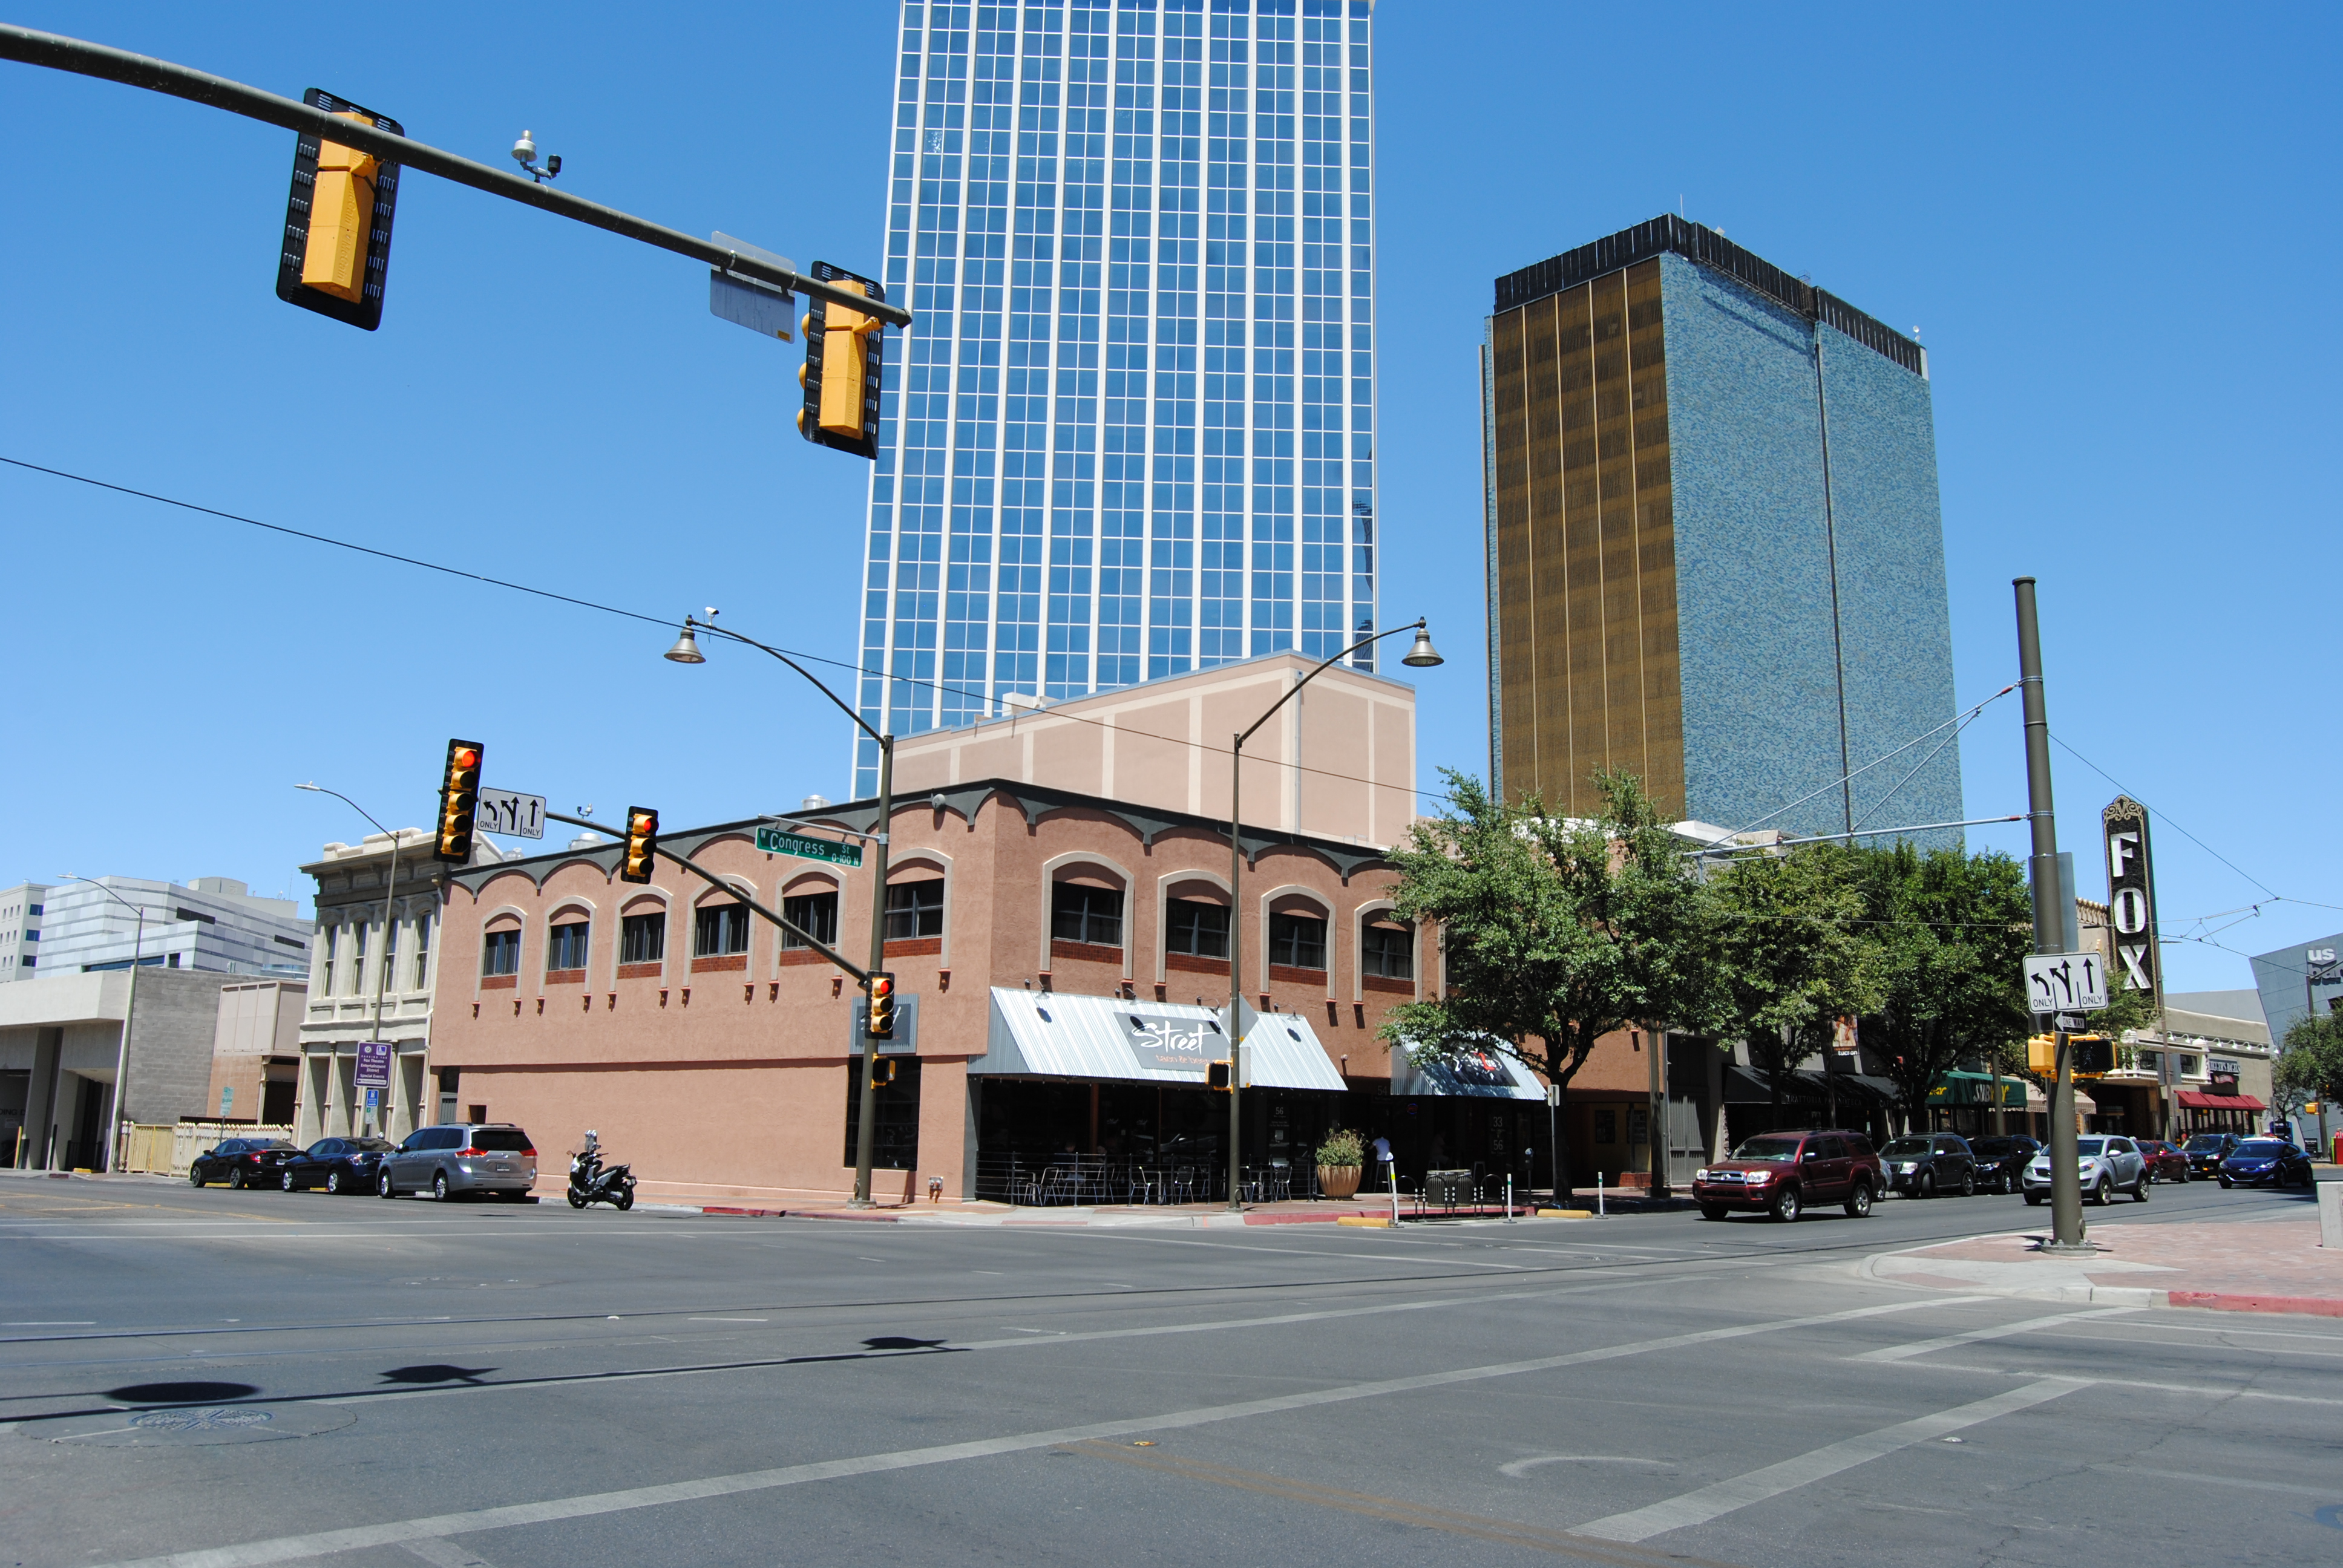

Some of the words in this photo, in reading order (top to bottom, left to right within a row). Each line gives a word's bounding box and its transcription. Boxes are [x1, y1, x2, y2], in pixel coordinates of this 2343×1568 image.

[337, 240, 351, 282] McCain
[480, 820, 499, 829] ONLY
[523, 828, 540, 837] ONLY
[760, 829, 766, 838] W
[770, 832, 825, 855] Congress
[842, 844, 850, 854] St
[831, 853, 851, 865] 0-100
[853, 857, 859, 866] N
[2110, 831, 2152, 990] FOX
[2308, 948, 2335, 961] us
[2033, 998, 2053, 1008] ONLY
[2082, 995, 2103, 1005] ONLY
[2063, 1018, 2072, 1027] ONE
[2073, 1018, 2083, 1028] WAY
[1131, 1020, 1216, 1055] Street
[1179, 1055, 1188, 1063] &
[1188, 1056, 1210, 1065] beer
[1377, 1085, 1388, 1096] 54
[1786, 1095, 1821, 1104] TRATTORIA
[1276, 1106, 1283, 1115] 56
[1493, 1140, 1503, 1151] 56
